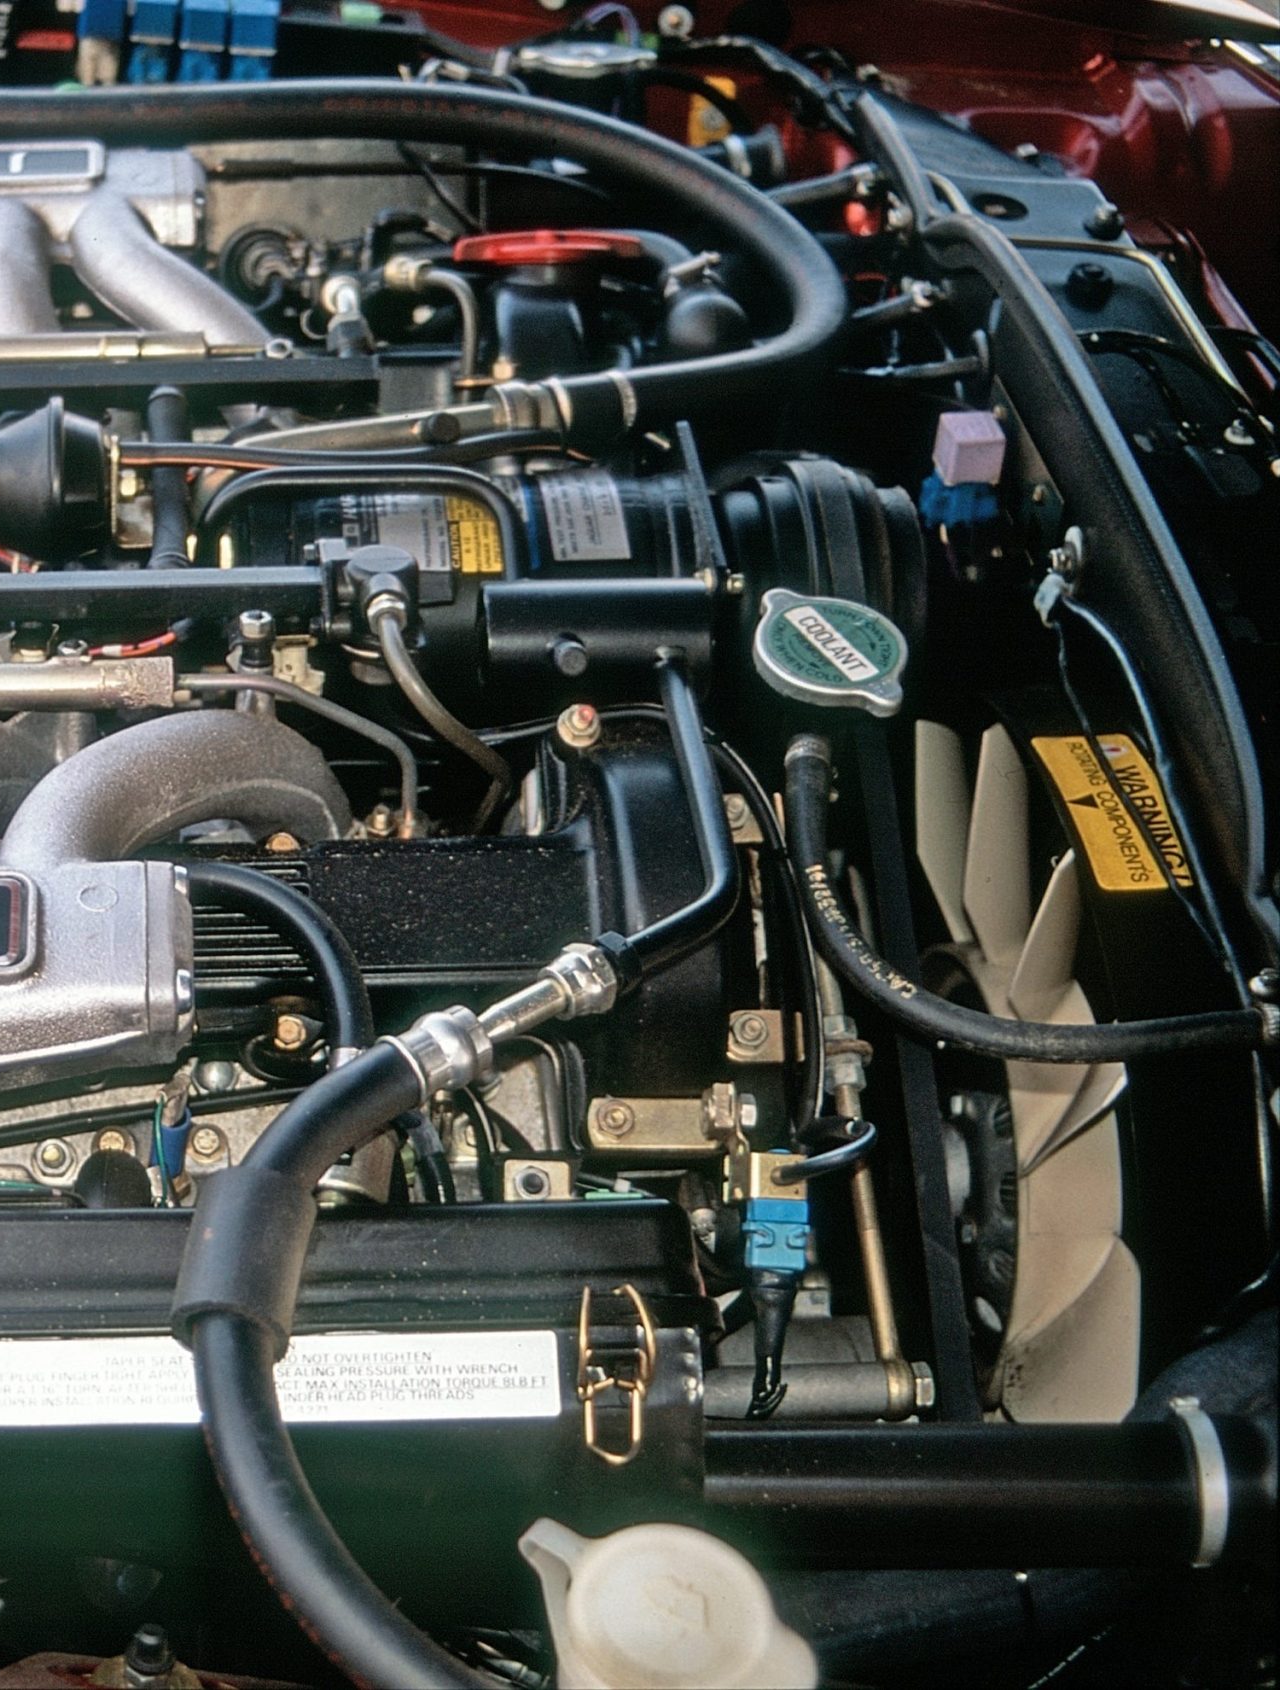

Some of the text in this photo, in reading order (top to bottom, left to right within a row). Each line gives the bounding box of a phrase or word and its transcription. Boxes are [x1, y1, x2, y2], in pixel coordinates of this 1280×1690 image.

[450, 524, 461, 569] CAUTION
[799, 616, 868, 671] COOLANT
[1070, 742, 1106, 786] ROTATING
[302, 1352, 328, 1364] NOT
[334, 1351, 432, 1364] OVERTIGHTEN
[277, 1363, 519, 1377] SEALING PRESSURE WITH WRENCH
[305, 1380, 337, 1390] MAX
[344, 1378, 440, 1390] INSTALLATION
[447, 1377, 498, 1389] TORQUE
[328, 1391, 366, 1401] HEAD
[371, 1390, 405, 1401] PLUG
[410, 1389, 475, 1400] THREADS
